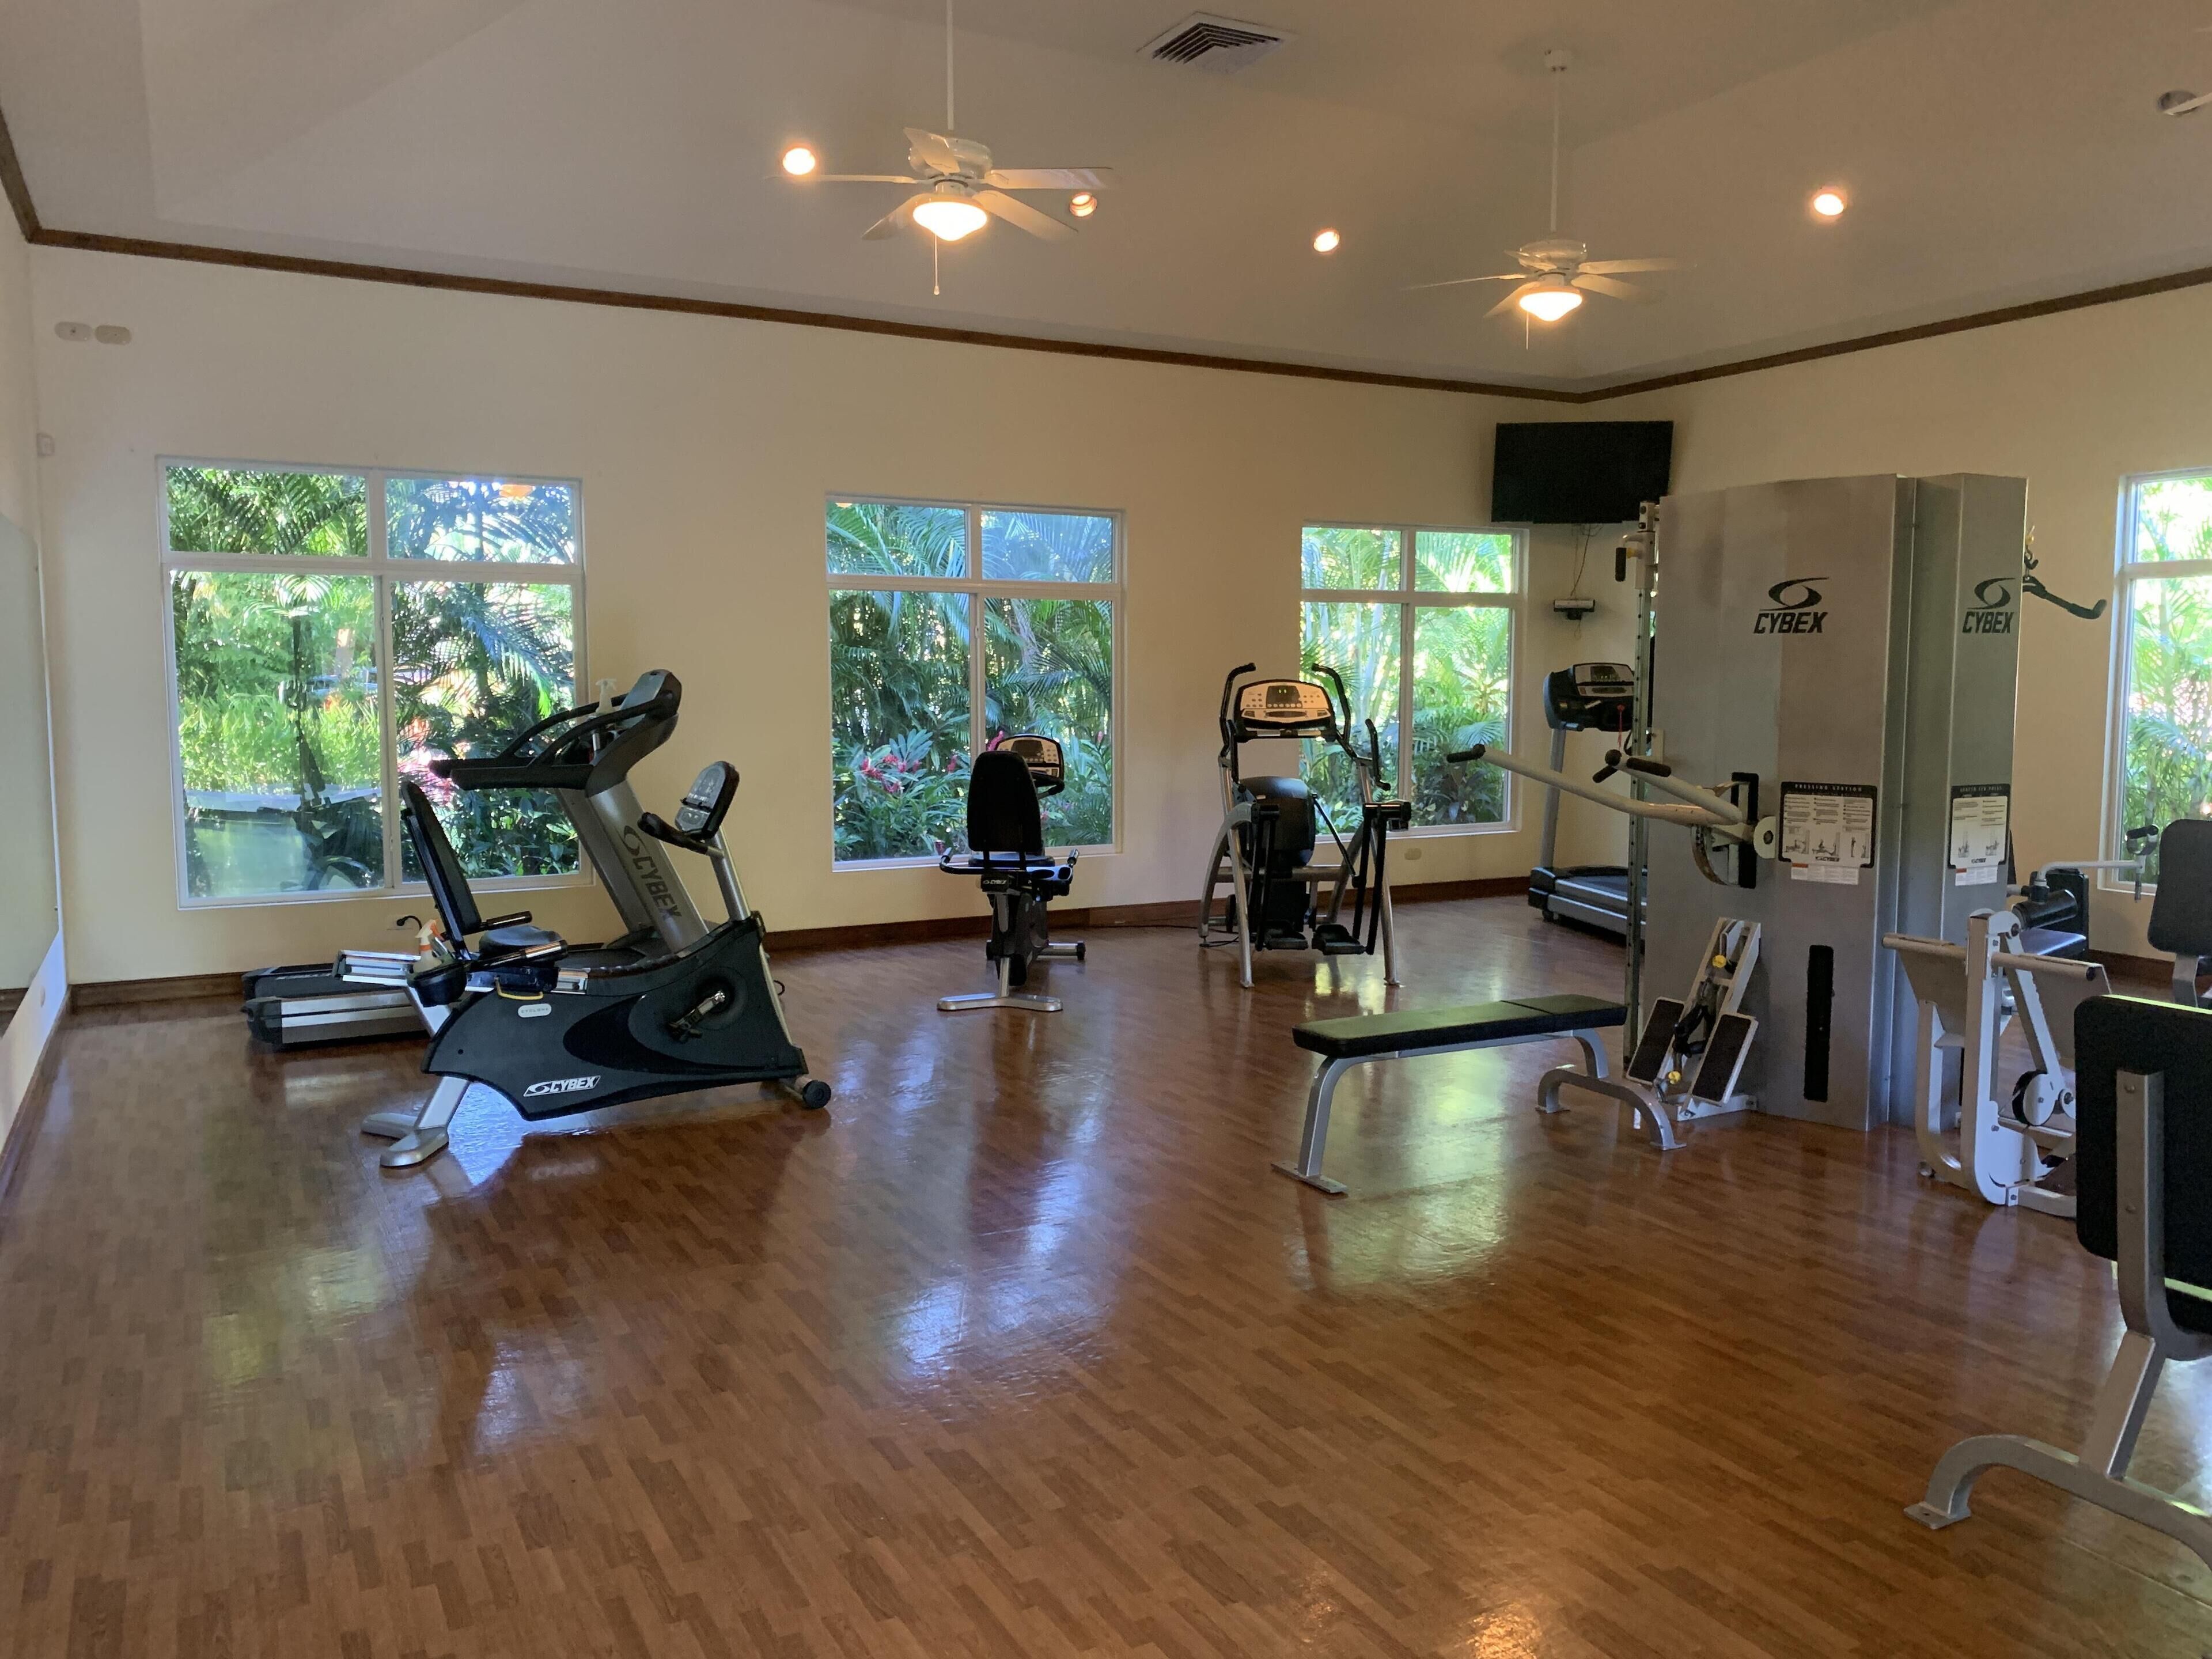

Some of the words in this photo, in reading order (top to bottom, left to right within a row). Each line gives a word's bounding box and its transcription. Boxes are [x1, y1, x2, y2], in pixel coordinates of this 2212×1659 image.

[1753, 611, 1828, 634] CYBEX
[1962, 611, 2014, 634] CYBEX
[632, 855, 683, 917] CYBEX
[549, 1076, 596, 1093] CYBEX
